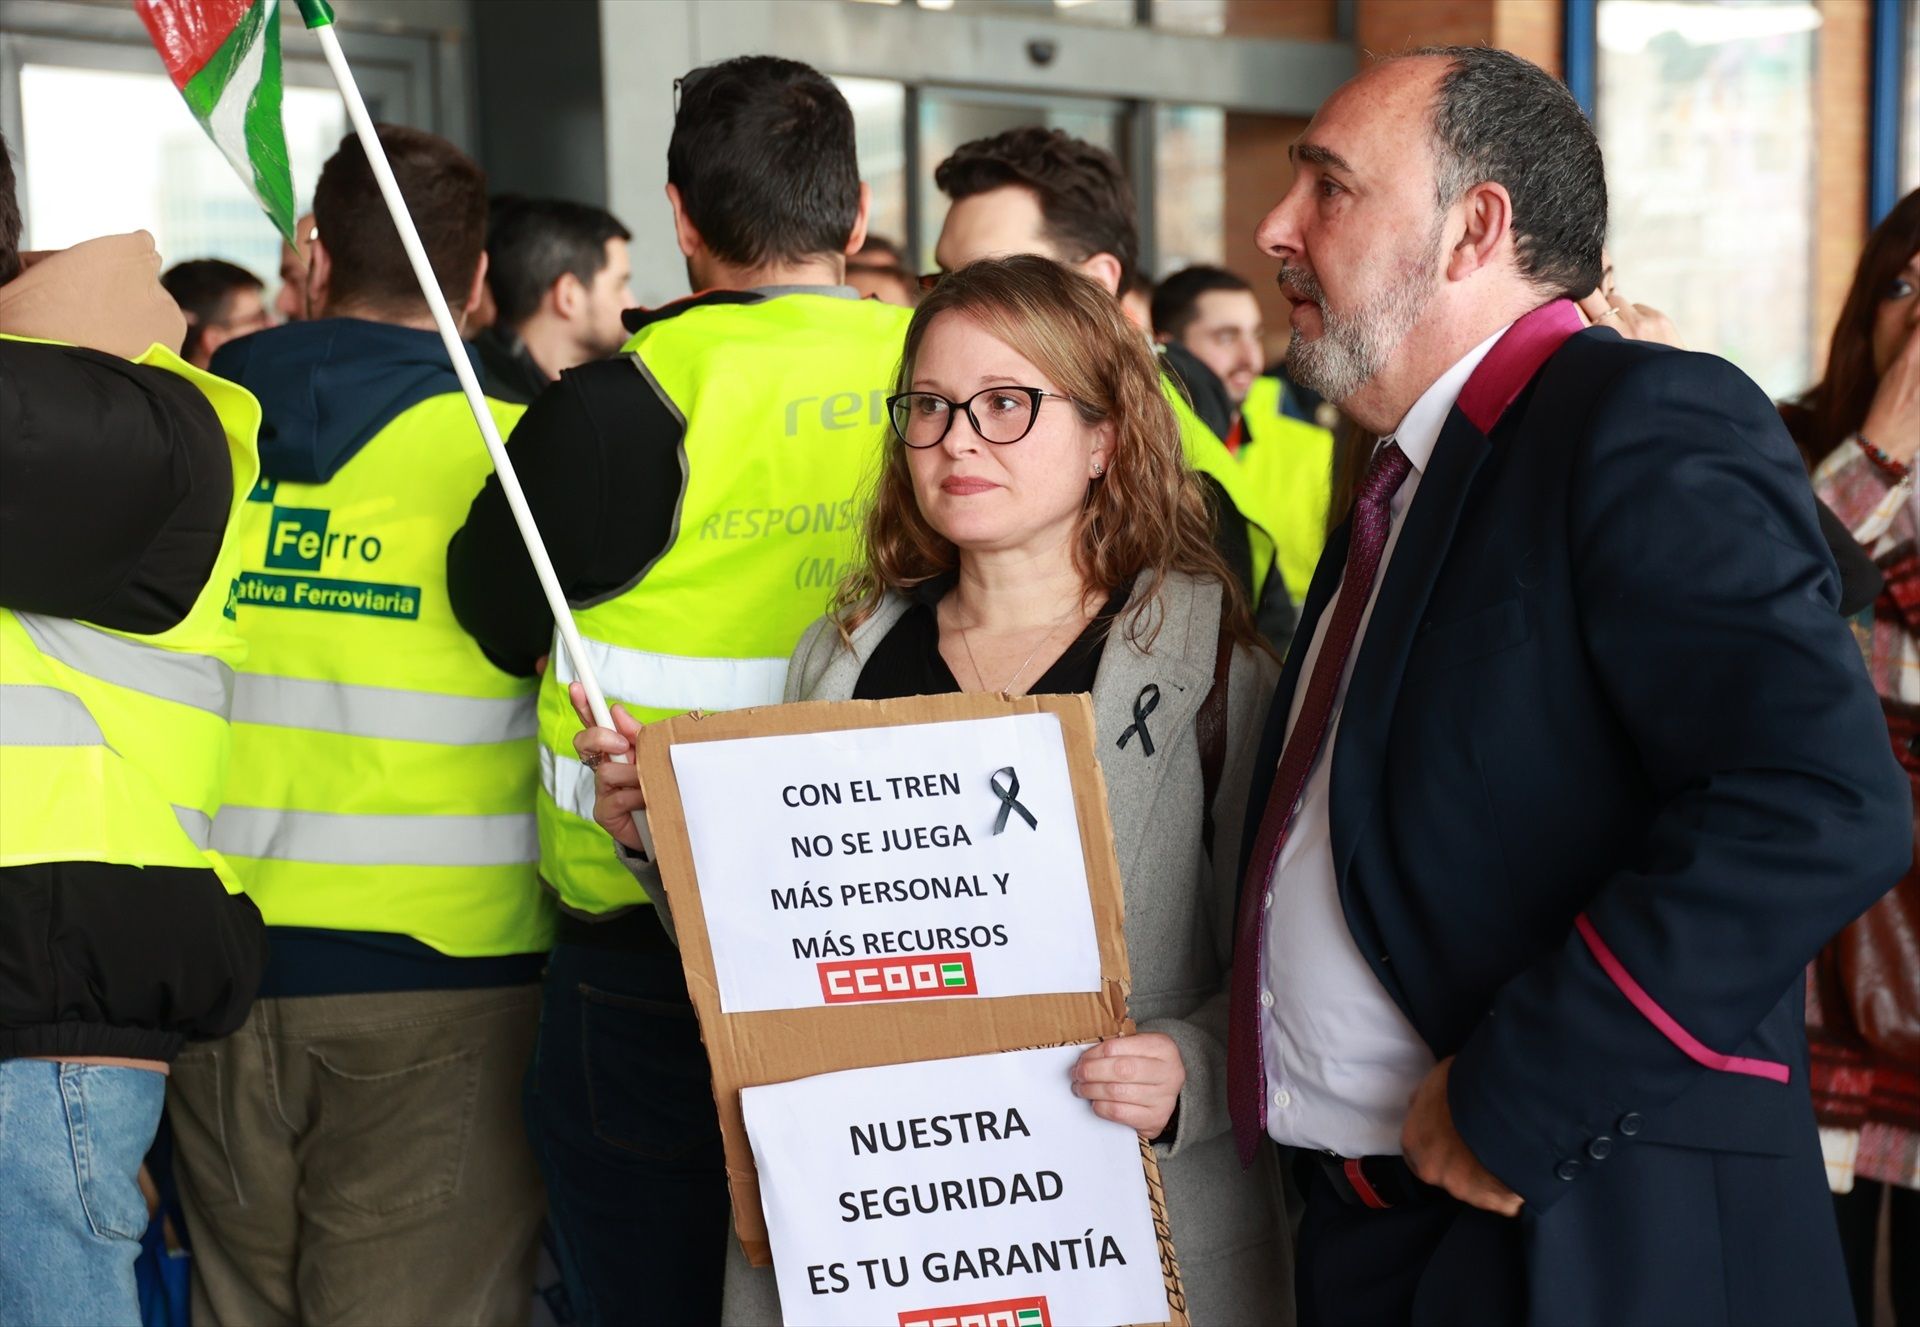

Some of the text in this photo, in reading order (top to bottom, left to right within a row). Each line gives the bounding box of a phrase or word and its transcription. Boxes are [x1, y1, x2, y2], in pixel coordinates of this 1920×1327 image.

[699, 499, 868, 541] RESPONS
[272, 521, 382, 562] Ferro
[293, 582, 415, 614] Ferroviaria
[782, 772, 961, 808] CON EL TREN
[791, 825, 972, 858] NO SE JUEGA
[770, 872, 1010, 910] MÁS PERSONAL Y
[792, 924, 1009, 959] MÁS RECURSOS
[826, 963, 939, 995] CCOO
[849, 1107, 1031, 1156] NUESTRA
[838, 1170, 1064, 1223] SEGURIDAD
[807, 1229, 1127, 1295] ES TU GARANTÍA
